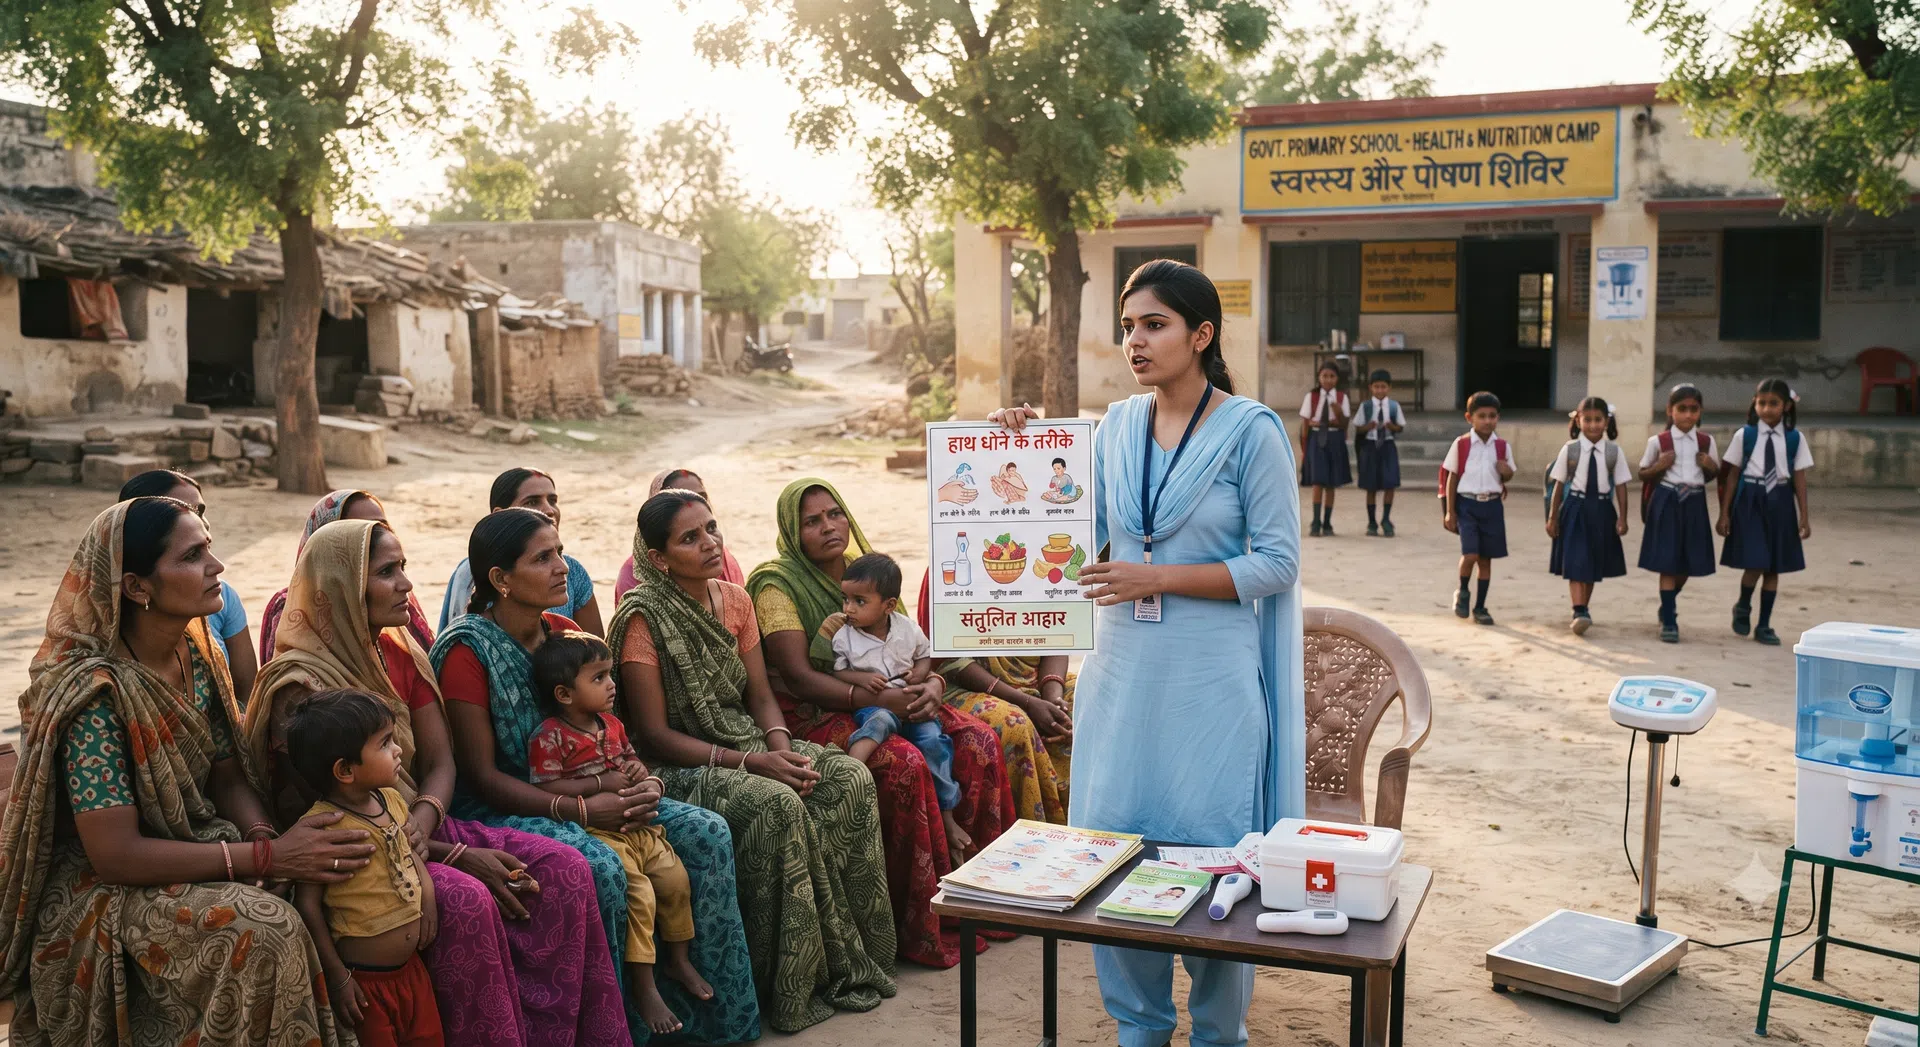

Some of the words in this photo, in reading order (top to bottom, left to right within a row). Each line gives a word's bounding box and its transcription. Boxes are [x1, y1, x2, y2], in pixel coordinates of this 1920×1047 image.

[1249, 139, 1286, 159] GOVT.
[1288, 136, 1347, 158] PRIMARY
[1350, 133, 1403, 154] SCHOOL
[1413, 130, 1465, 151] HEALTH
[1466, 133, 1474, 148] &
[1477, 124, 1553, 148] NUTRITION
[1556, 122, 1600, 143] CAMP
[1360, 156, 1408, 191] और
[1413, 156, 1482, 189] पोषण
[1488, 151, 1568, 188] शिविर
[947, 436, 976, 453] हाथ
[980, 431, 1010, 451] धोने
[1014, 431, 1030, 449] के
[1033, 429, 1074, 449] तरीके
[959, 607, 1017, 633] संतुलित
[1022, 611, 1067, 629] आहार
